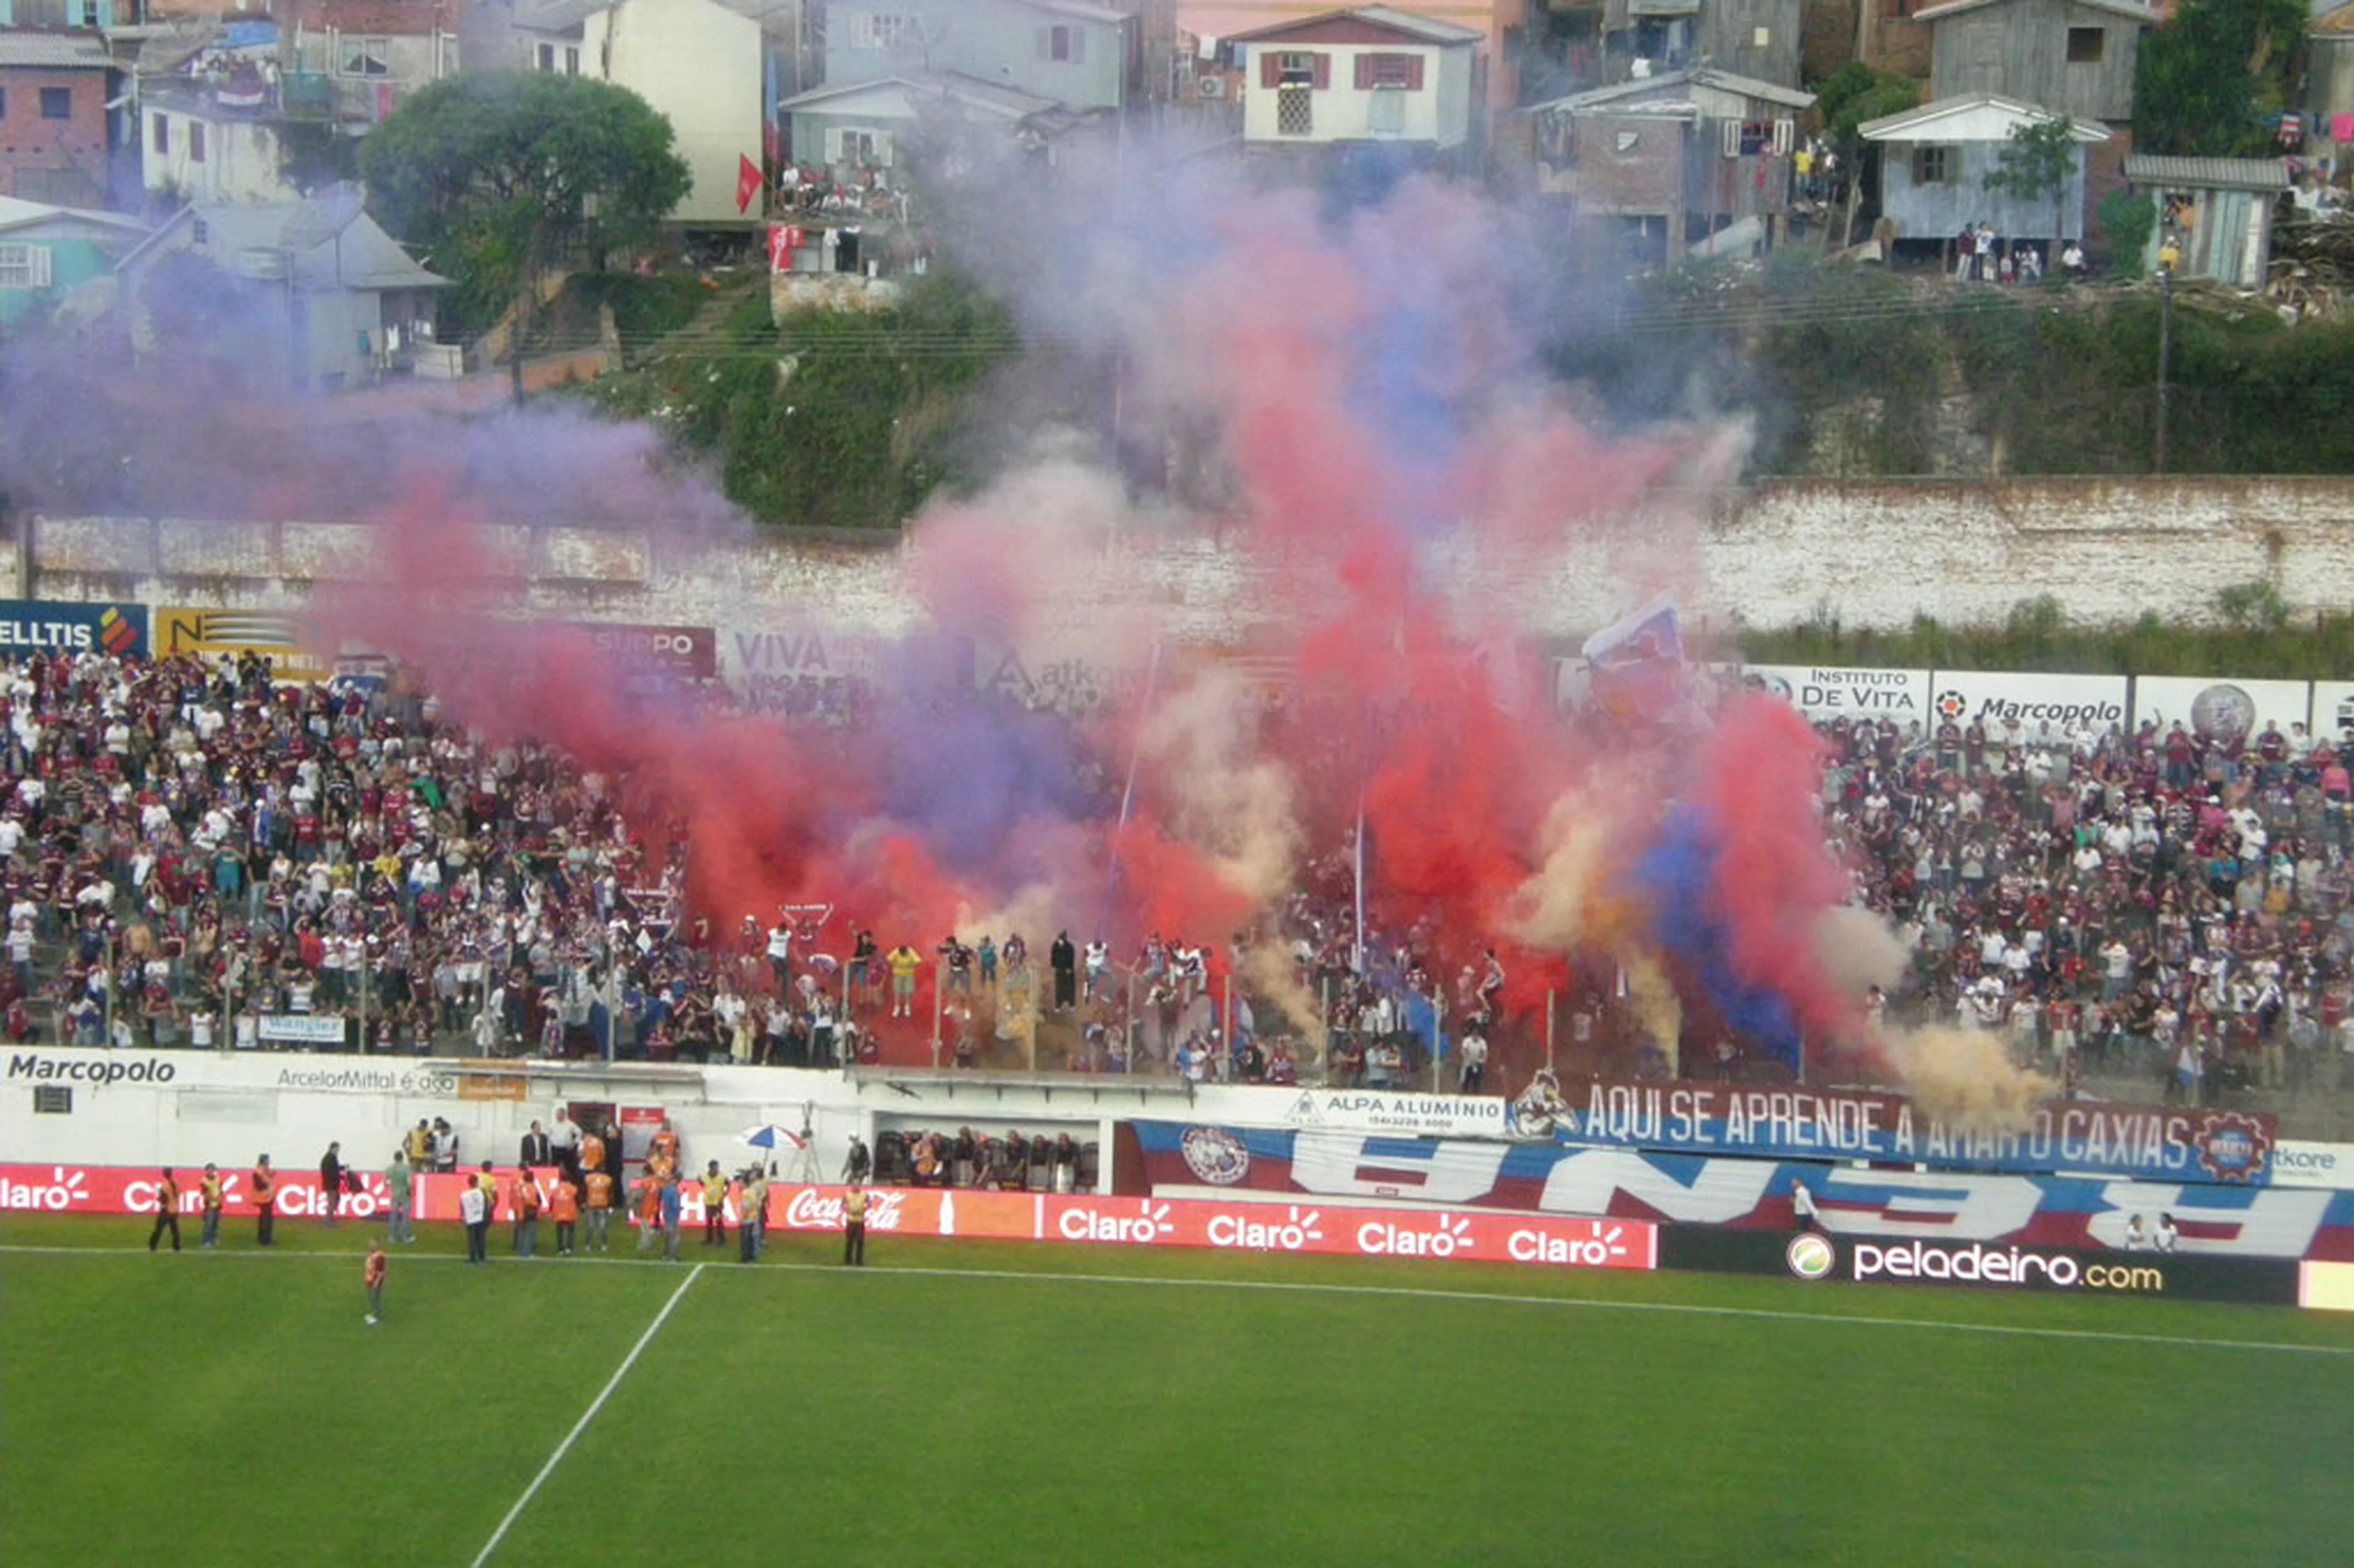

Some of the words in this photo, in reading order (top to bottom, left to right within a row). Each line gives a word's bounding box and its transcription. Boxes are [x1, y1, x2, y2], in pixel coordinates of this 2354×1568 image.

[734, 633, 829, 671] VIVA
[1811, 669, 1908, 685] INSTITUTO
[1802, 686, 1842, 706] DE
[1852, 687, 1914, 709] VITA
[1981, 698, 2121, 724] Marcopolo
[8, 1054, 175, 1084] Marcopolo
[278, 1068, 395, 1089] ArcelorMittal
[1327, 1096, 1385, 1112] ALPA
[1585, 1084, 1661, 1141] AQUI
[1670, 1090, 1715, 1143] SE
[1724, 1091, 1884, 1153] APRENDE
[1894, 1104, 1916, 1156] A
[2029, 1109, 2053, 1159] O
[2060, 1109, 2190, 1169] CAXIAS
[2271, 1147, 2337, 1169] tkore
[0, 1177, 70, 1211] laro
[1059, 1208, 1156, 1243] Claro
[1208, 1216, 1303, 1249] Claro
[1357, 1222, 1455, 1257] Claro
[1508, 1230, 1607, 1265] Claro
